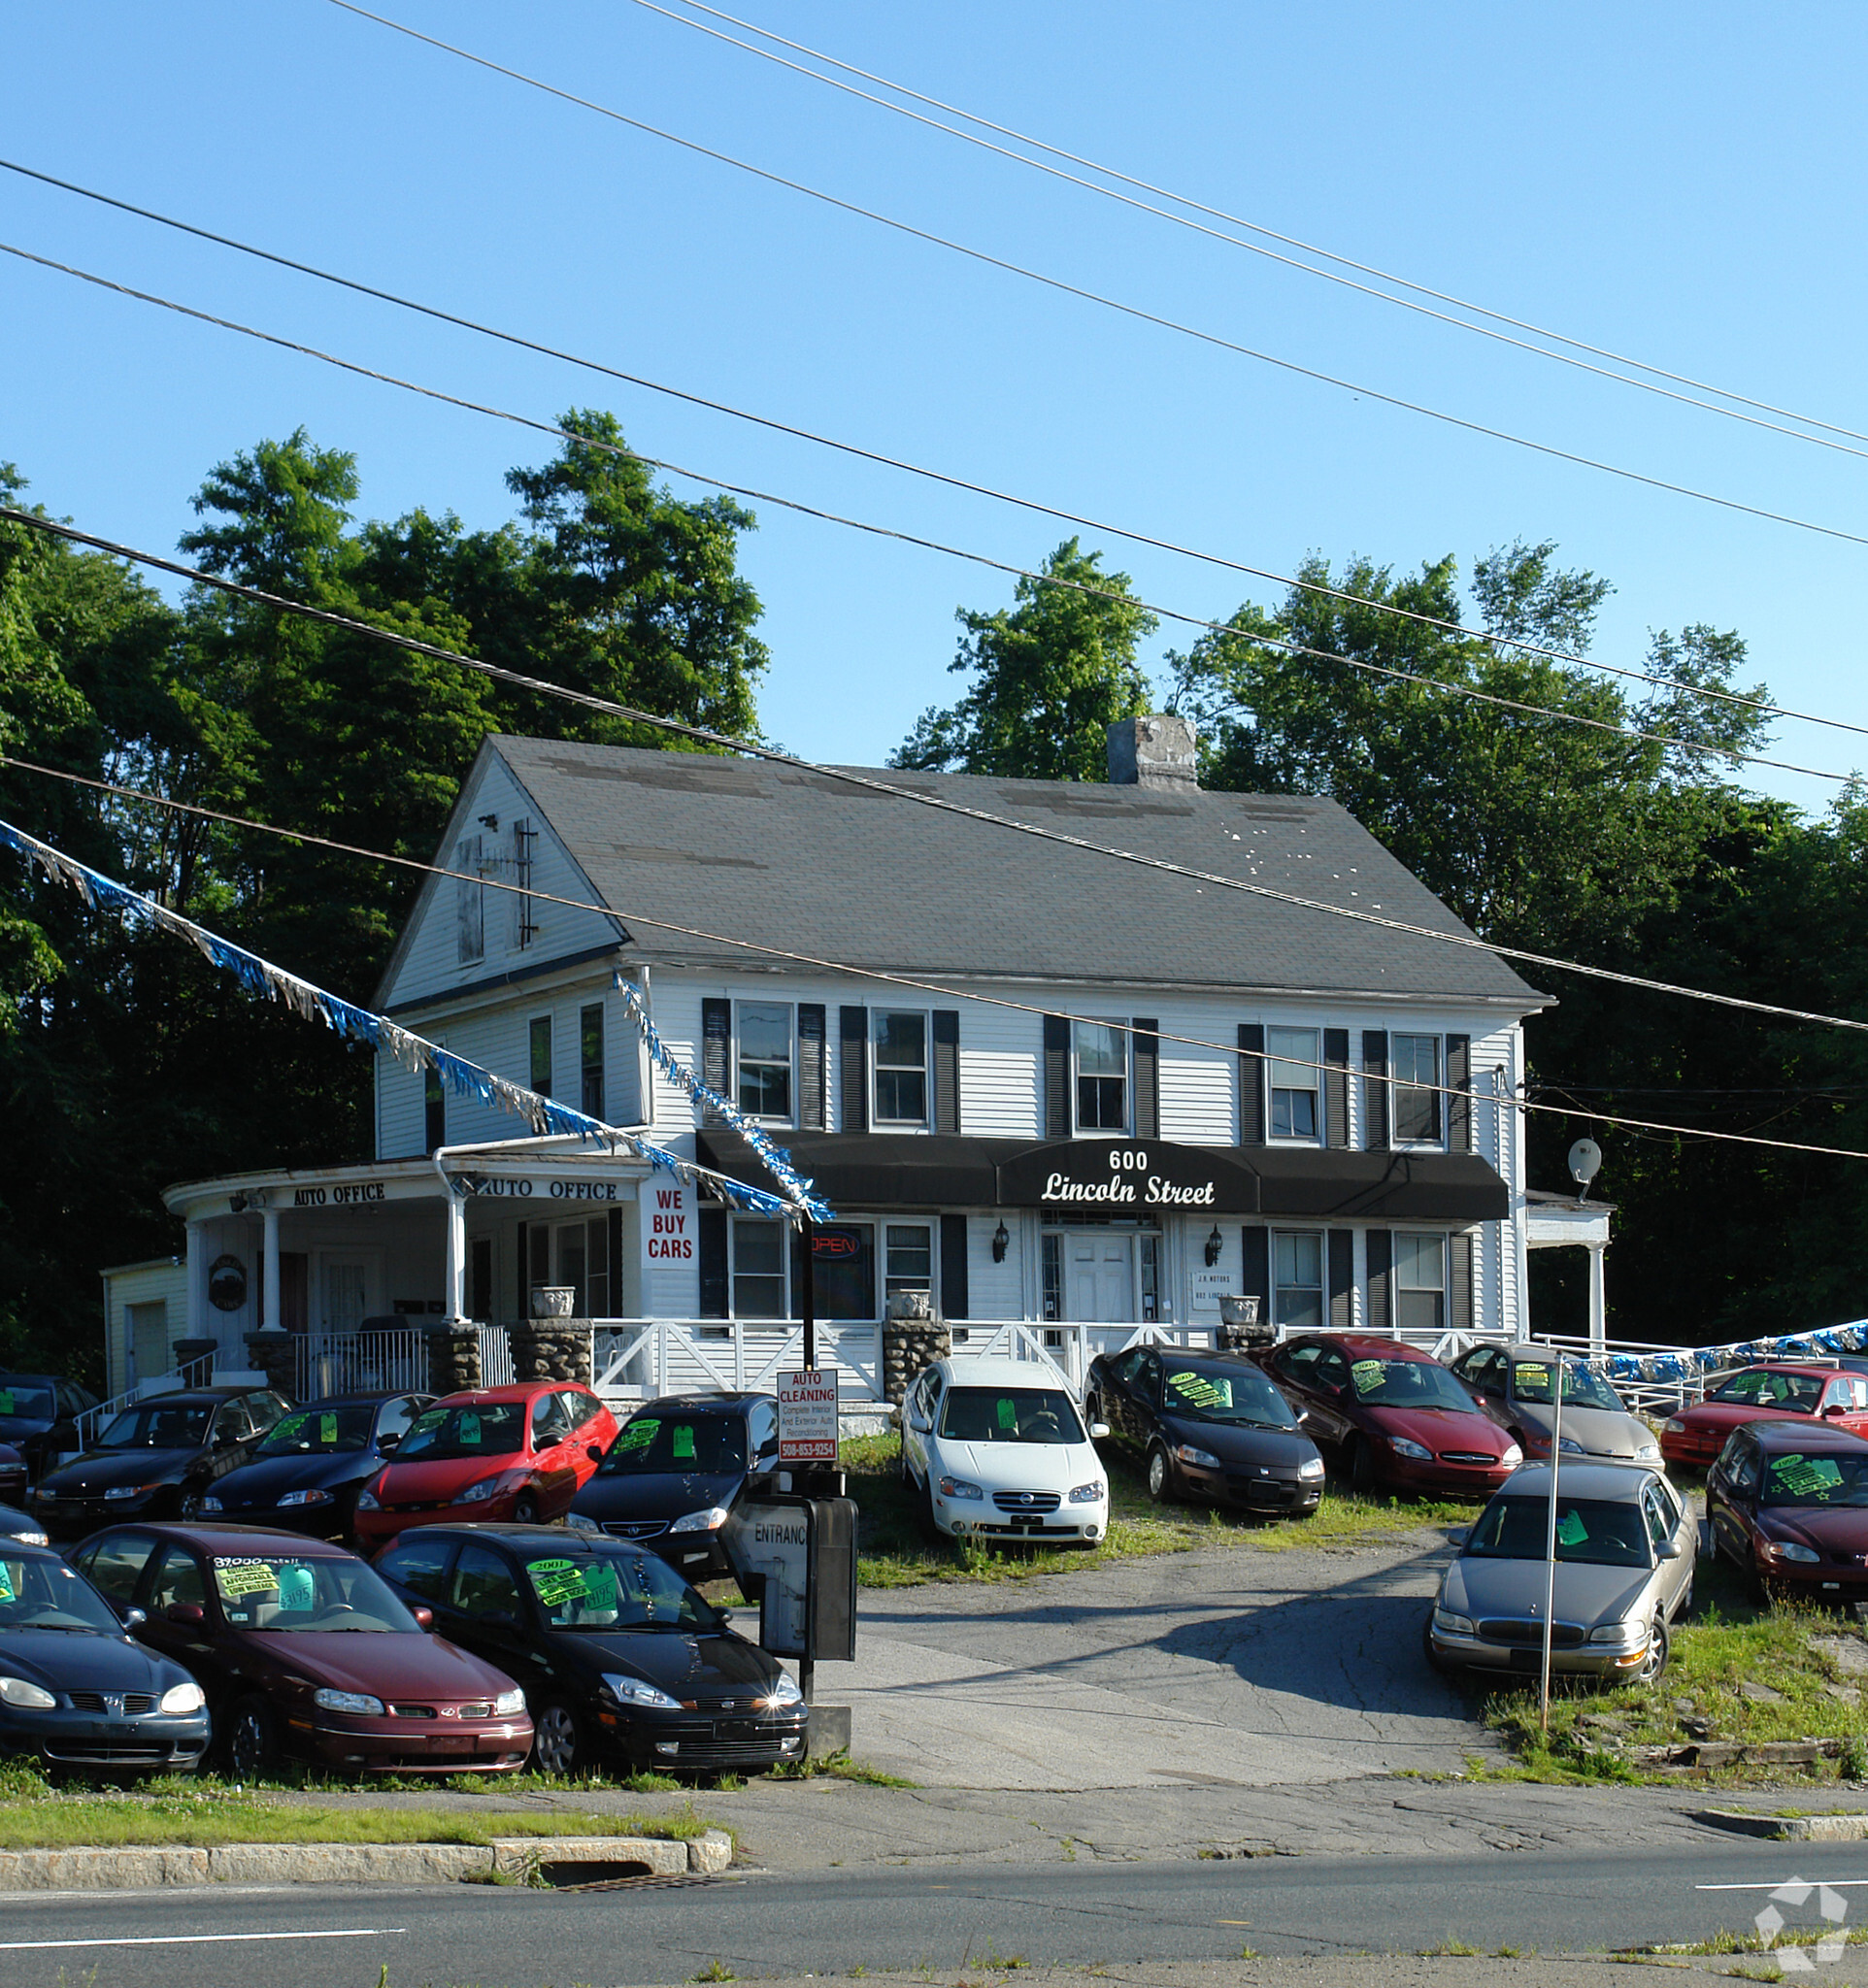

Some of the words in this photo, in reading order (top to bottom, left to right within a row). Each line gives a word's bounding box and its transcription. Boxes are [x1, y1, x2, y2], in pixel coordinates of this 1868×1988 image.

[1109, 1150, 1148, 1171] 600
[294, 1187, 326, 1207] AUTO
[333, 1182, 385, 1204] OFFICE
[550, 1180, 617, 1200] OFFICE
[1041, 1173, 1136, 1203] Lincoln
[1145, 1176, 1215, 1205] Street
[656, 1190, 683, 1209] WE
[653, 1214, 685, 1234] BUY
[649, 1239, 692, 1259] CARS
[792, 1373, 821, 1385] AUTO
[780, 1388, 835, 1403] CLEANING
[783, 1406, 810, 1415] Complete
[782, 1417, 793, 1426] And
[795, 1416, 817, 1426] Exterior
[820, 1416, 834, 1425] Auto
[786, 1428, 828, 1439] Reconditioning
[782, 1442, 834, 1456] 508-853-9254
[1779, 1456, 1798, 1468] 1999
[755, 1523, 808, 1545] ENTRANC
[214, 1557, 263, 1568] 89,000
[226, 1565, 265, 1574] AUTOMATIC
[536, 1561, 564, 1571] 2001
[225, 1573, 272, 1585] AFFORDABLE
[539, 1576, 558, 1587] LIKE
[557, 1571, 577, 1580] NEW
[229, 1586, 246, 1595] LOW
[246, 1581, 274, 1592] MILEAGE
[545, 1593, 568, 1605] MOON
